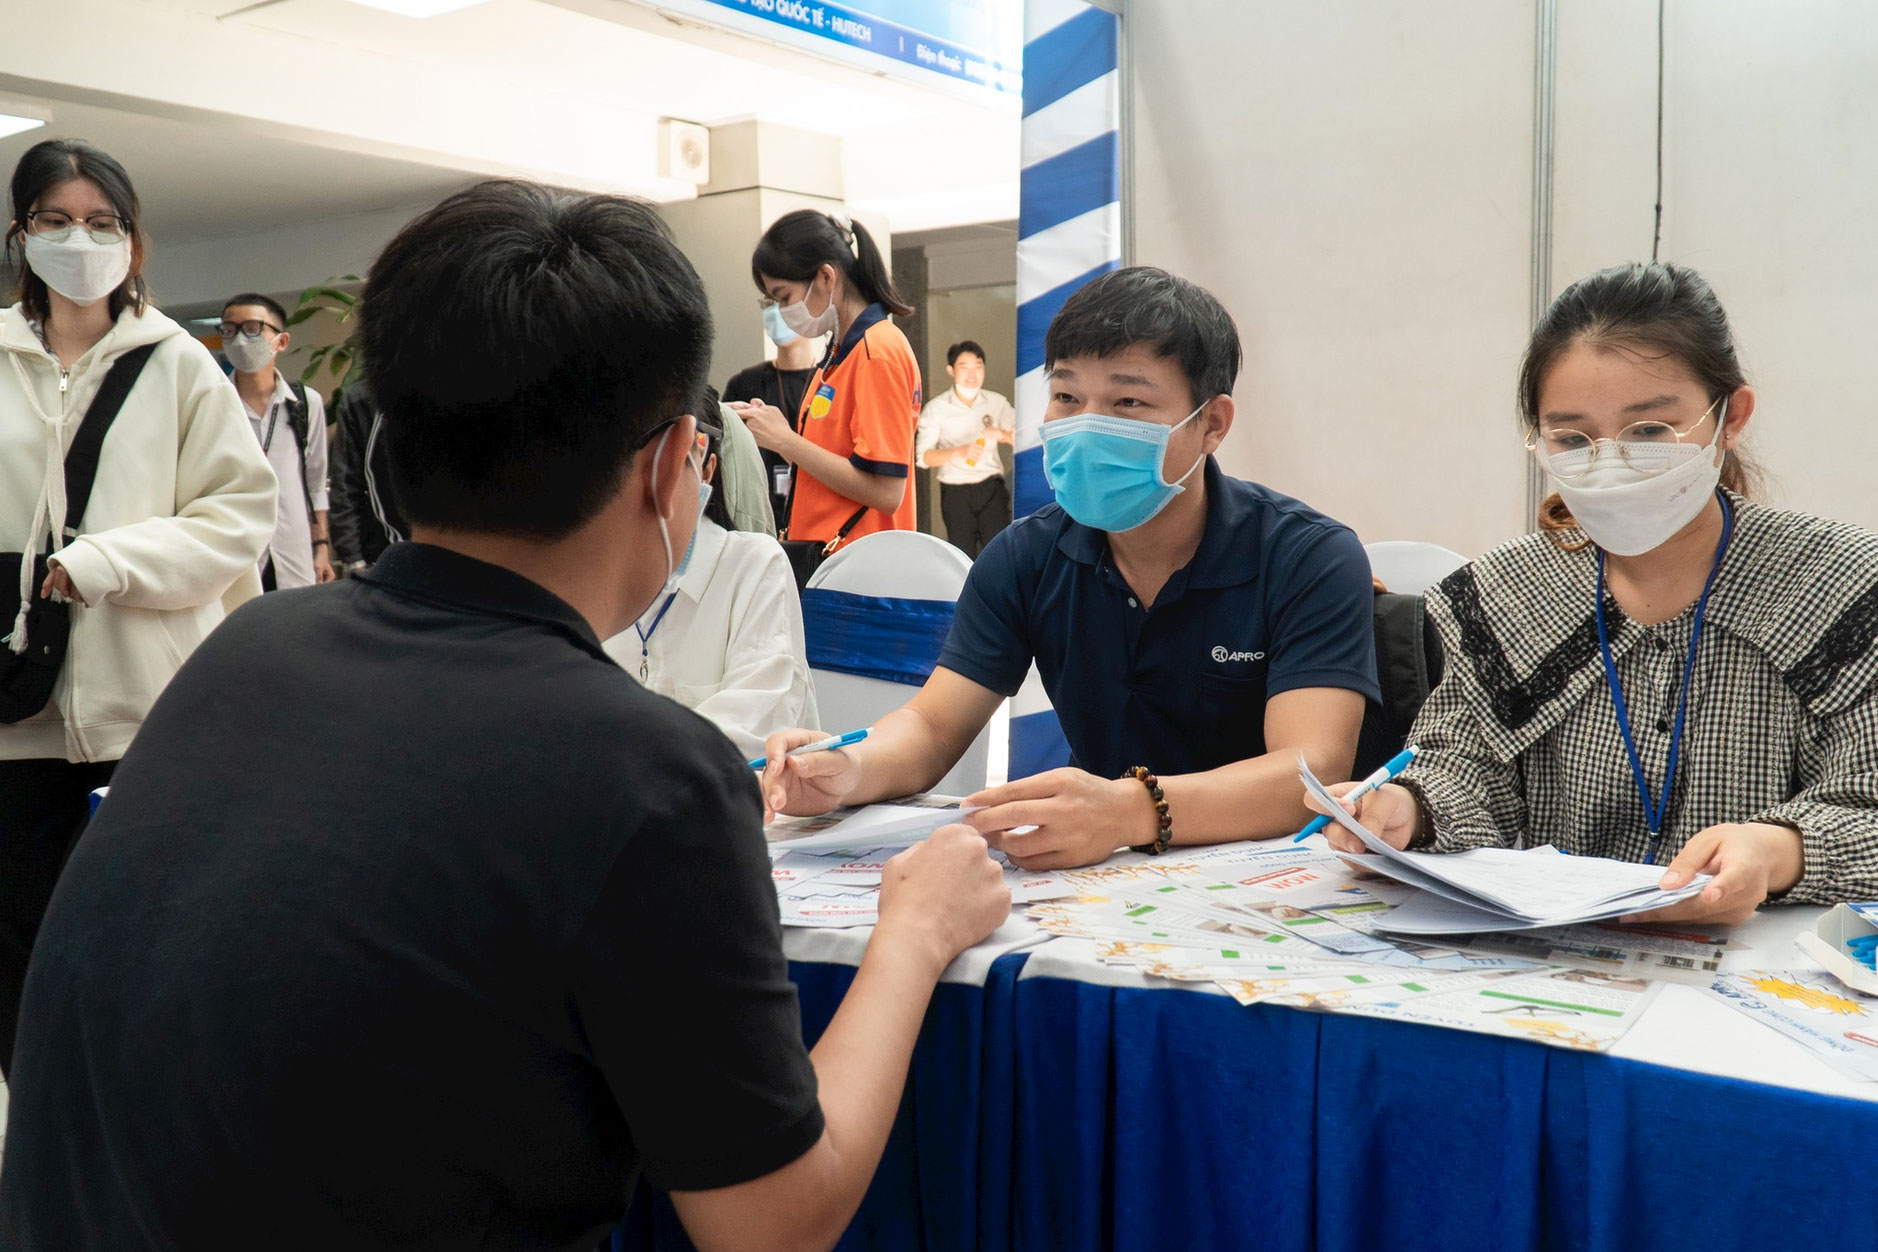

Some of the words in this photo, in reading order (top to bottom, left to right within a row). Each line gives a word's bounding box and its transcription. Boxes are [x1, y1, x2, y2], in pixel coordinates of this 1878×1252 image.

[775, 0, 811, 24] QUỐC
[811, 7, 825, 28] TẾ
[831, 16, 872, 42] HUTECH
[1228, 651, 1265, 662] APRO
